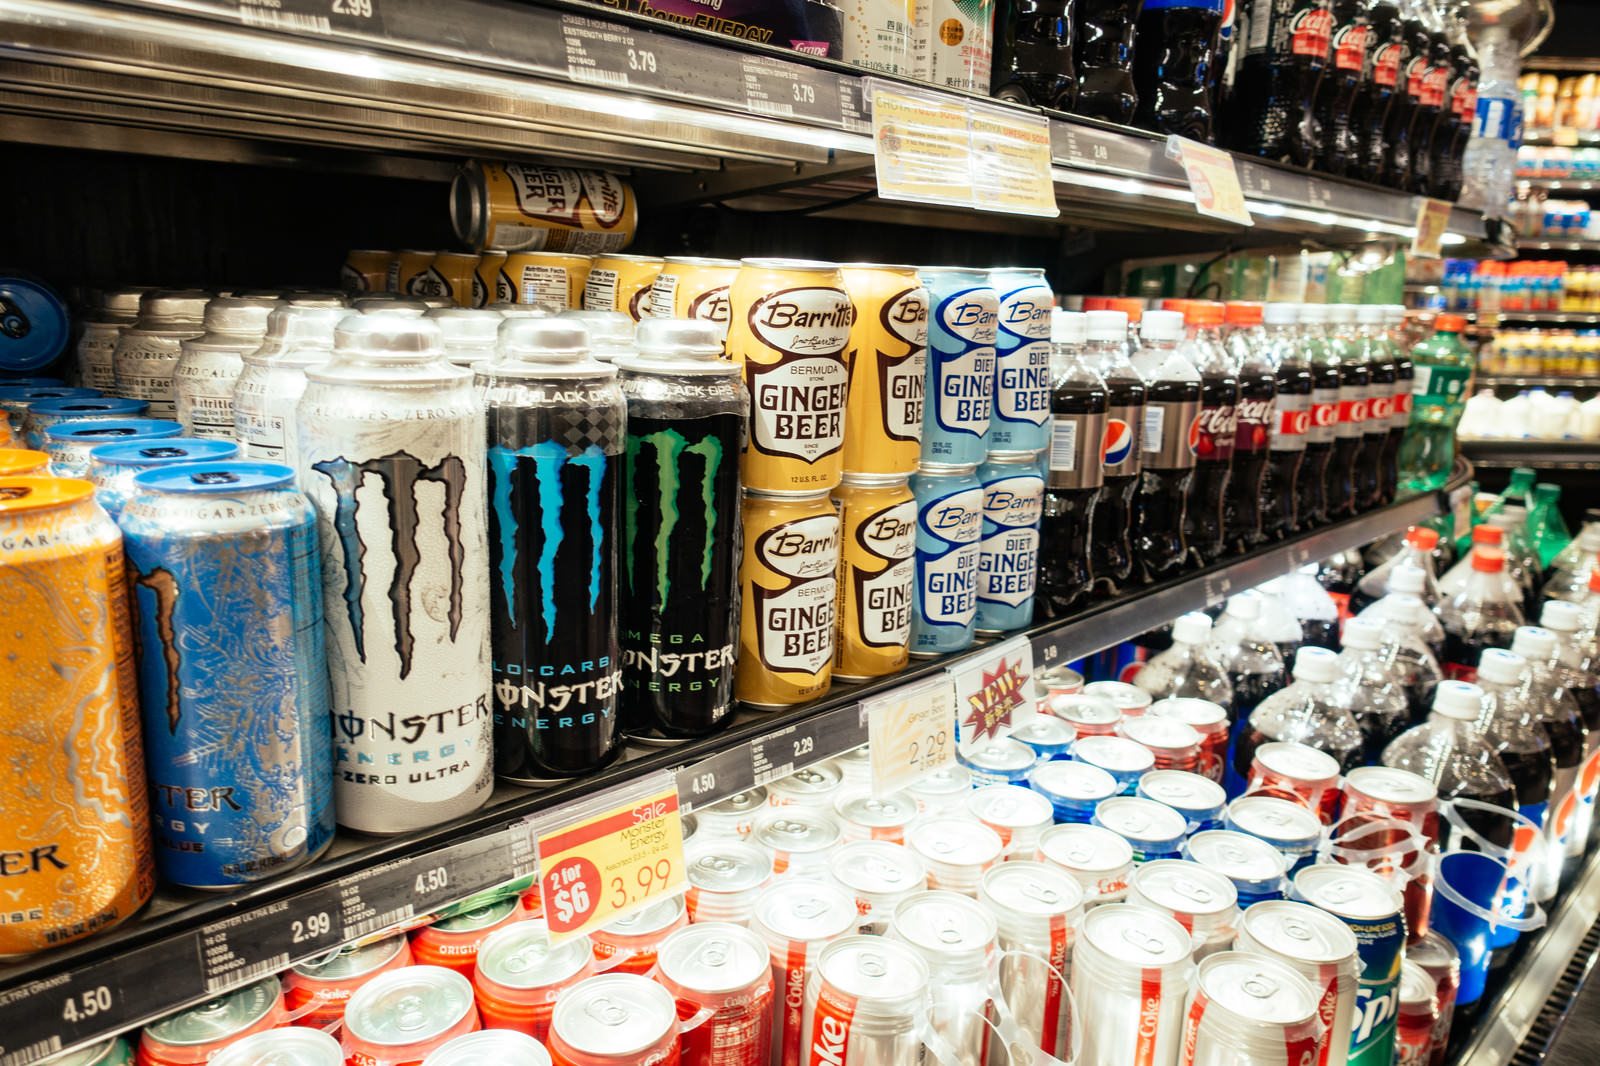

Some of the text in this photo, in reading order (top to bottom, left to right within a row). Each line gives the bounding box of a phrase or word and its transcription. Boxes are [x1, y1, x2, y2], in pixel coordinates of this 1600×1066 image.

[628, 48, 657, 73] 3.79
[792, 83, 815, 104] 3.79
[790, 365, 838, 376] BERMUDA
[759, 384, 848, 413] GINGER
[774, 414, 841, 440] BEER
[1006, 538, 1032, 551] DIET
[494, 706, 612, 729] ENERGY
[336, 736, 473, 767] ENERGY
[793, 736, 814, 757] 2.29
[909, 730, 947, 765] 2.29
[409, 760, 471, 784] ULTRA
[692, 773, 715, 795] 4.50
[632, 801, 667, 825] Sale
[619, 817, 665, 842] Monster
[629, 831, 667, 851] Energy
[349, 884, 360, 895] OZ
[415, 866, 448, 894] 4.50
[551, 864, 581, 890] 2 for
[610, 858, 671, 909] 3.99
[554, 881, 590, 923] $6
[203, 900, 289, 935] MONSTER ULTRA BLUE
[291, 911, 331, 944] 2.99
[214, 932, 228, 943] OZ
[1050, 941, 1066, 982] Coke
[30, 973, 72, 995] ORANGE
[785, 967, 804, 1009] Coke
[63, 985, 112, 1022] 4.50
[1138, 994, 1160, 1038] Coke
